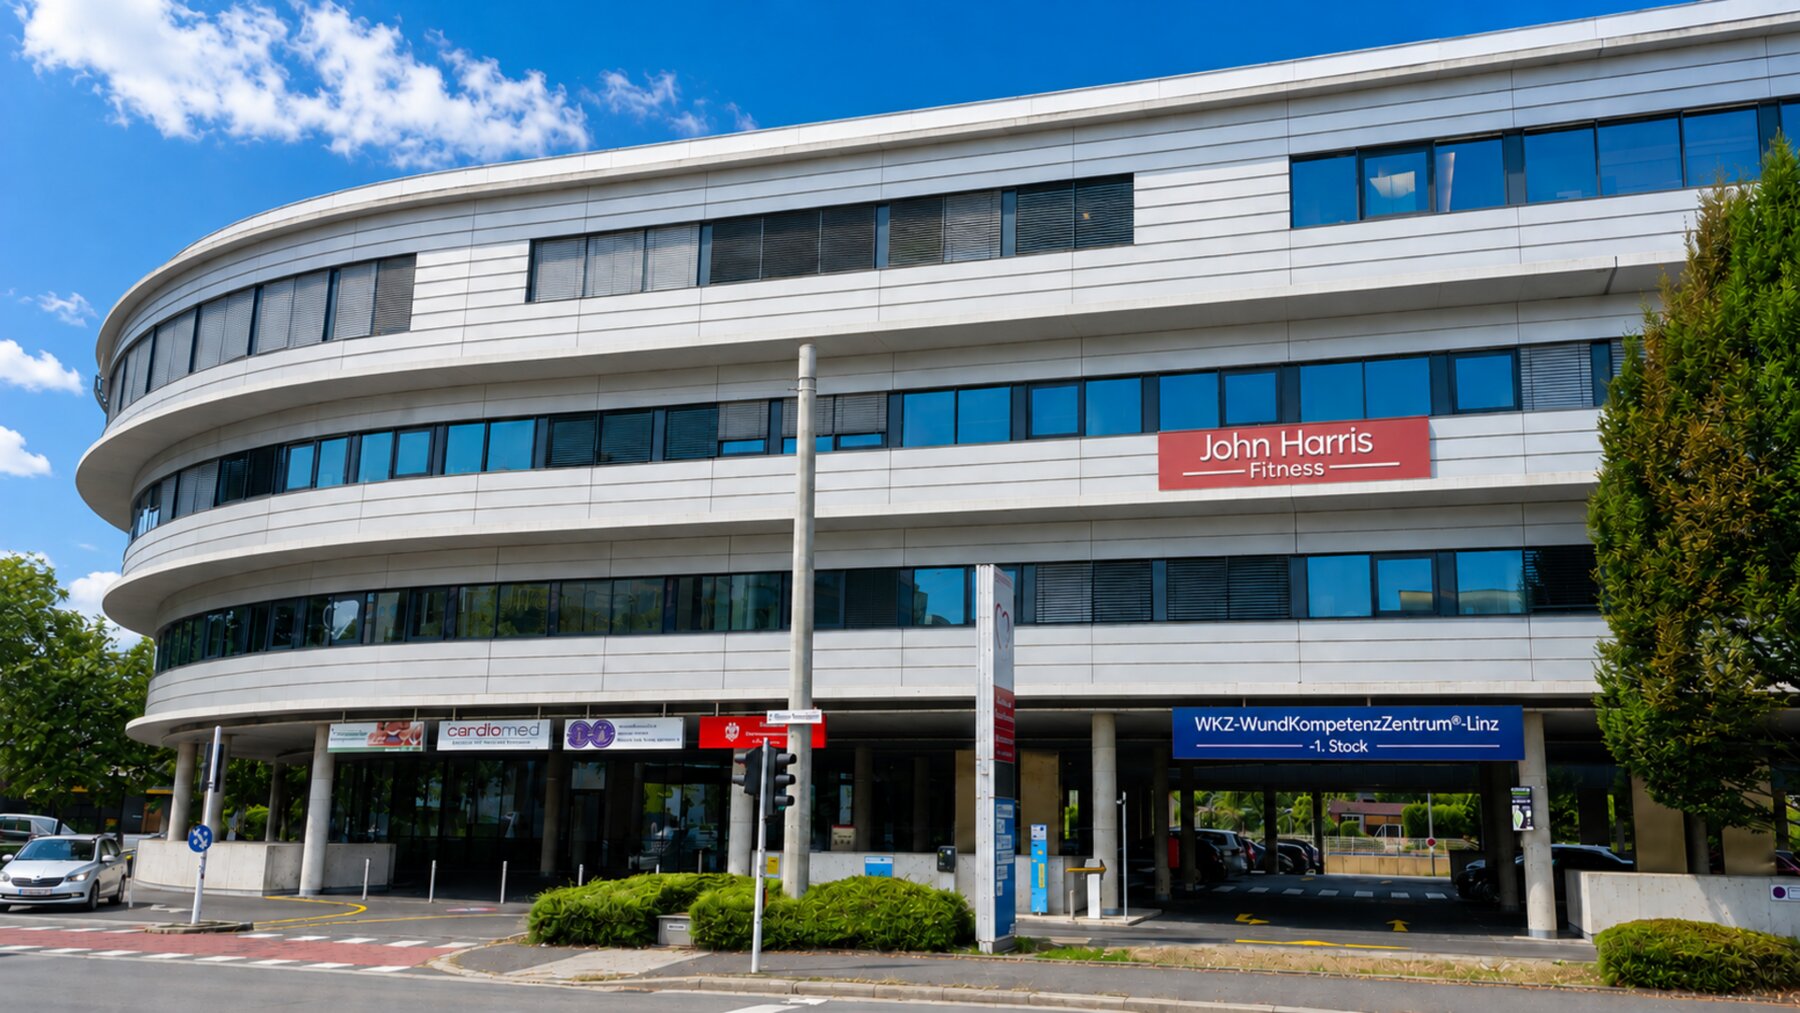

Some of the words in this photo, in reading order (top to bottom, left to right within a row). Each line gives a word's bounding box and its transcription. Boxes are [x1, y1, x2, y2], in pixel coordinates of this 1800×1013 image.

[1200, 432, 1270, 461] John
[1281, 427, 1374, 457] Harris
[1250, 462, 1325, 479] Fitness
[447, 722, 540, 737] cardiomed
[1329, 739, 1368, 752] Stock
